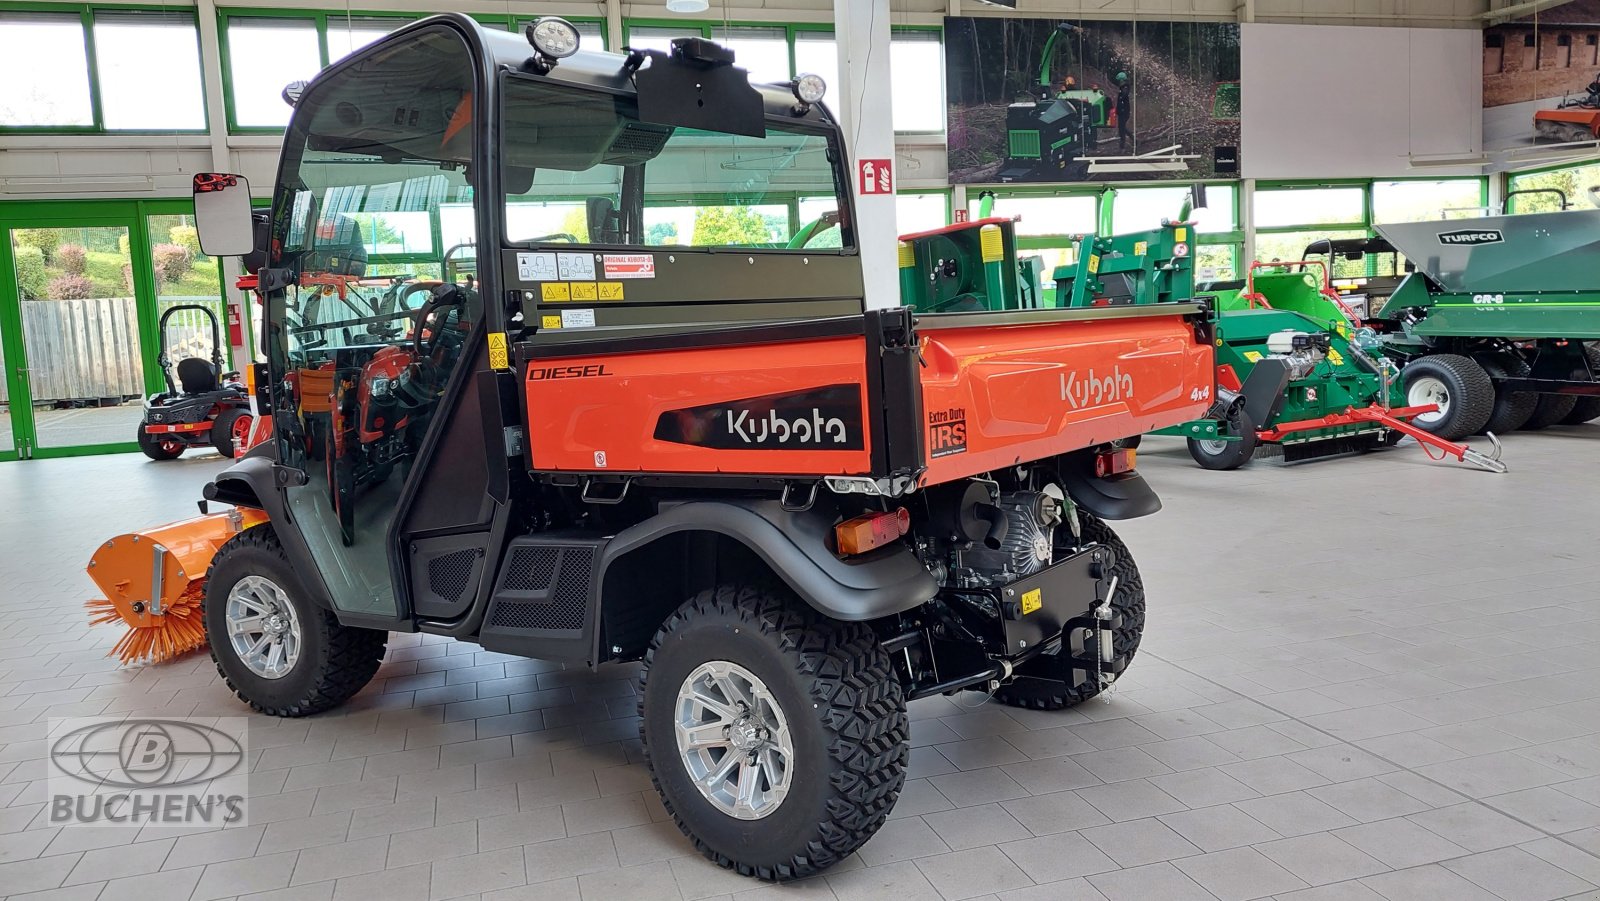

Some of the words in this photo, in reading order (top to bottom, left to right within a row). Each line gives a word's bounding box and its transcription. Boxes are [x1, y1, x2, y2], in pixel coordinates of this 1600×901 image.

[1442, 233, 1497, 242] TURFCO
[1473, 294, 1504, 304] GR-8
[529, 365, 613, 380] DIESEL
[1060, 365, 1134, 409] Kubota
[1190, 385, 1210, 402] 4x4
[929, 411, 948, 424] Extra
[949, 408, 966, 420] Duty
[727, 408, 847, 443] Kubota
[931, 423, 967, 450] IRS
